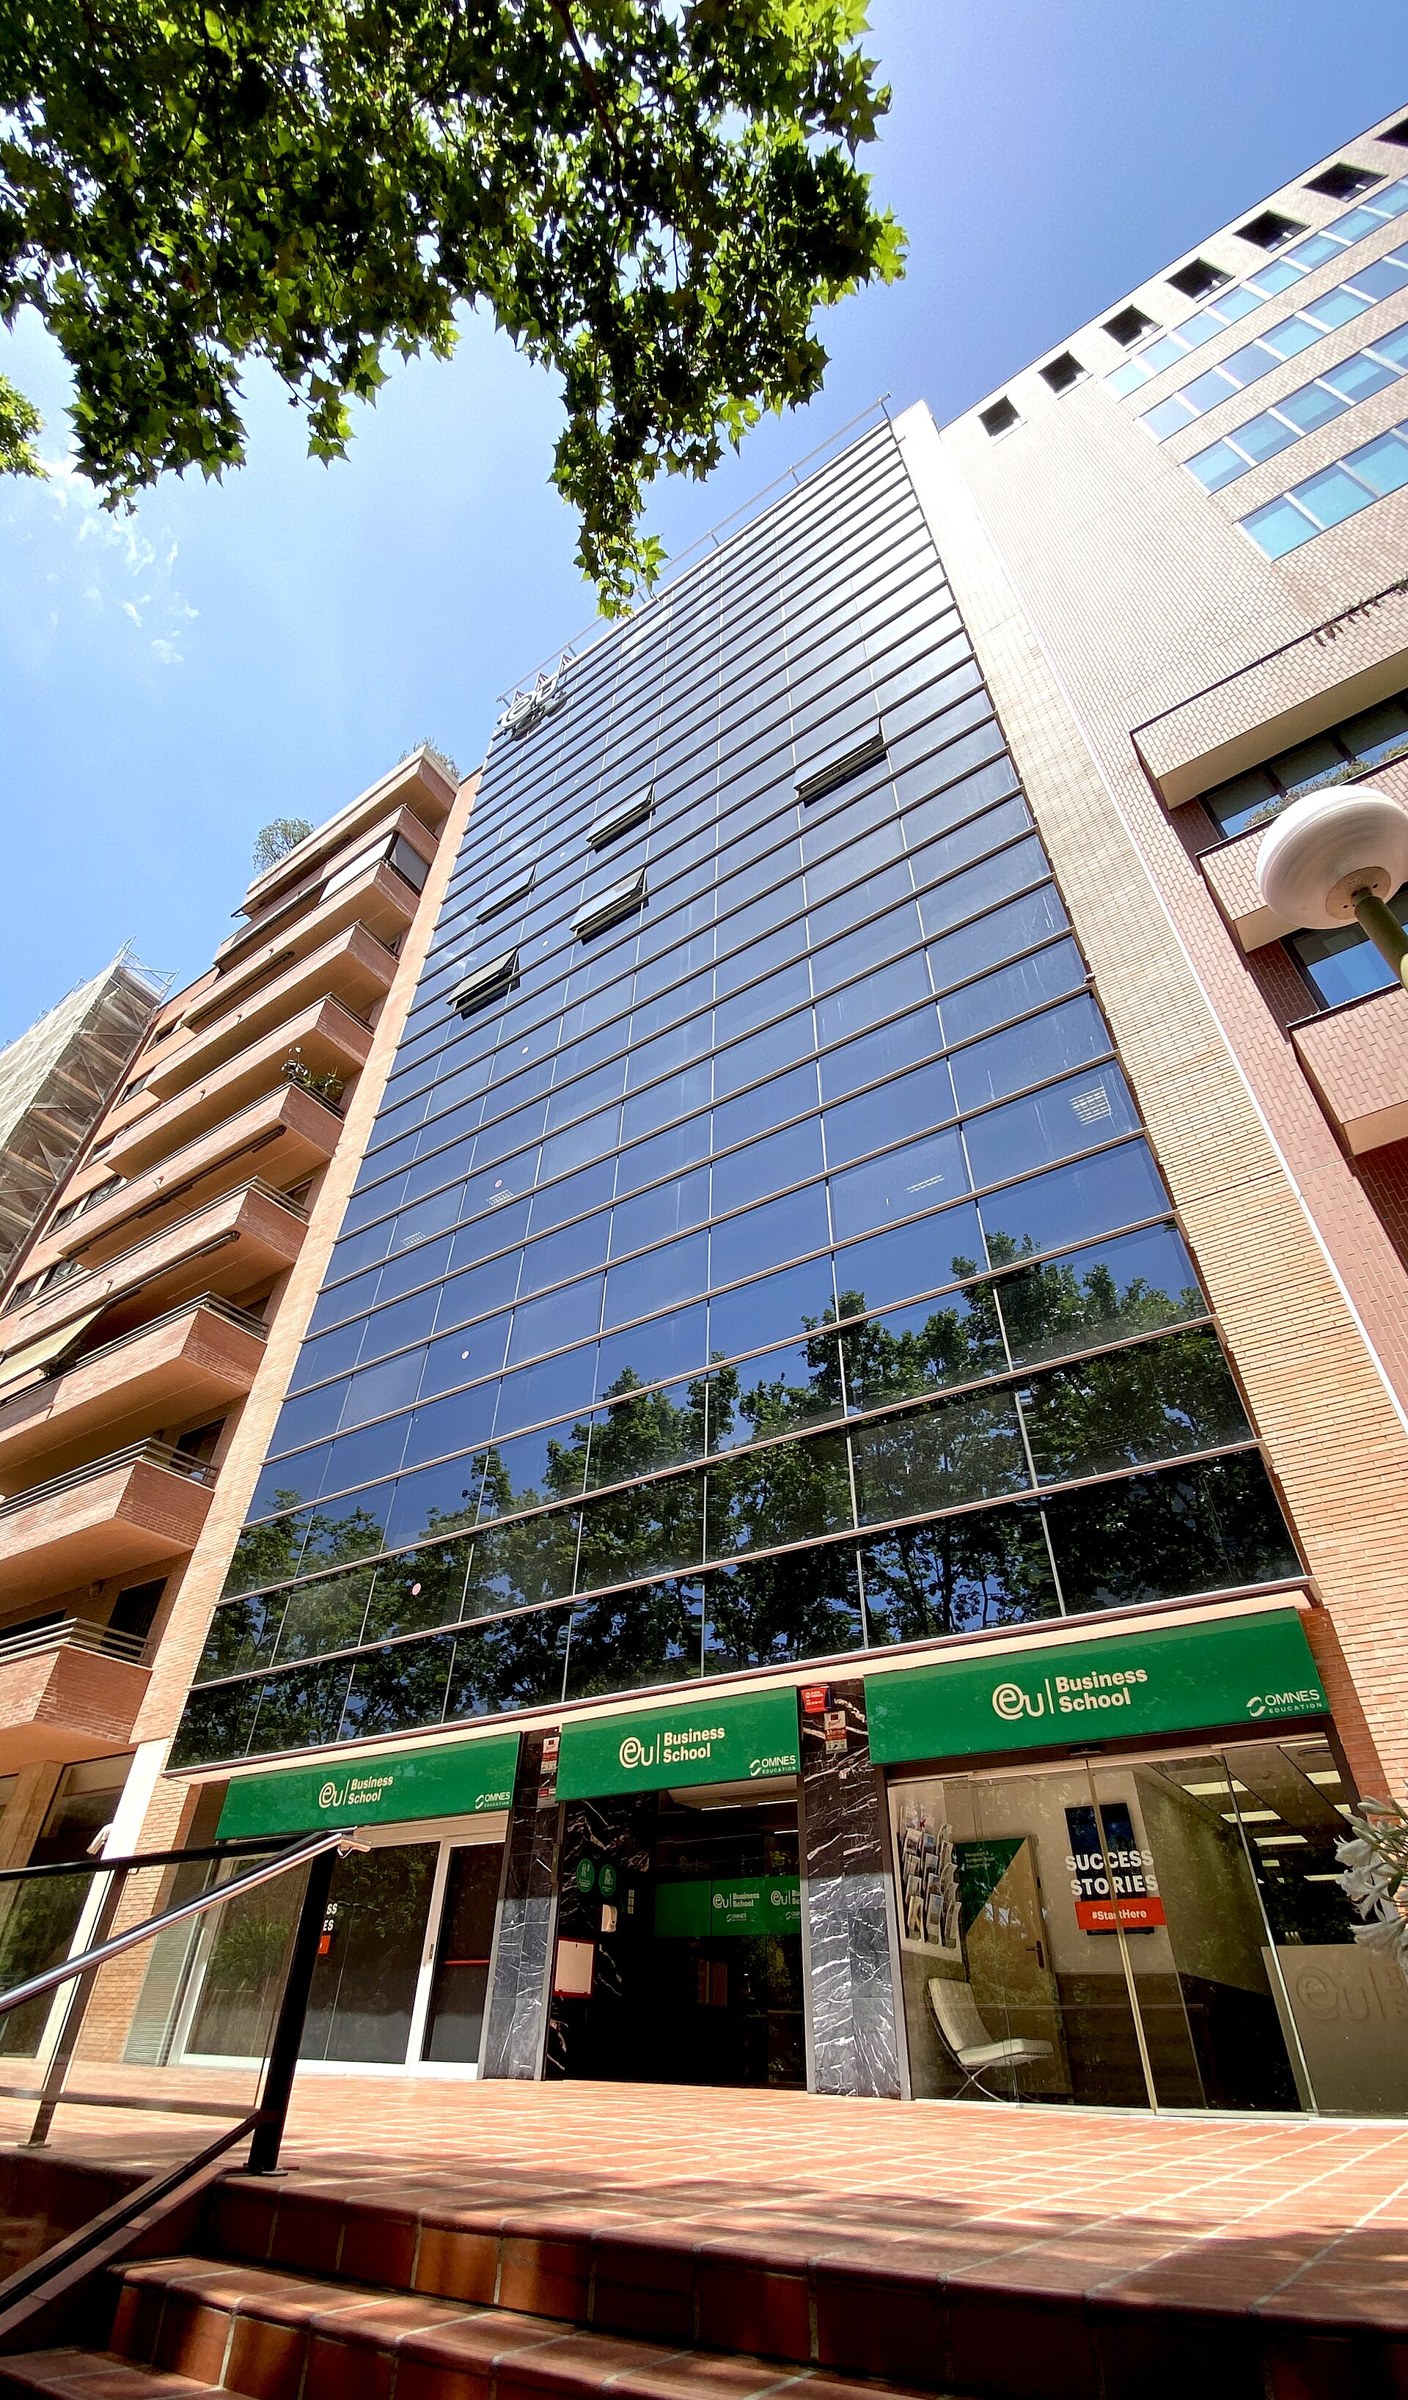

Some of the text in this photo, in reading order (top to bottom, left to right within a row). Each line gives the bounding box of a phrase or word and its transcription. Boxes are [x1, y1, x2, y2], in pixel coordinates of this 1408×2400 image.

[1055, 1668, 1148, 1694] Business
[992, 1682, 1045, 1721] eu
[1059, 1687, 1132, 1713] School
[1265, 1689, 1321, 1706] OMNES
[1268, 1702, 1323, 1714] EDUCATION
[663, 1726, 726, 1747] Business
[619, 1736, 655, 1769] eu
[663, 1743, 711, 1764] School
[761, 1755, 796, 1768] OMNES
[762, 1766, 797, 1775] EDUCATION
[350, 1775, 394, 1791] Business
[318, 1781, 344, 1809] eu
[347, 1788, 382, 1805] School
[484, 1791, 511, 1803] OMNES
[1065, 1849, 1154, 1872] SUCCESS
[1070, 1874, 1159, 1896] STORIES
